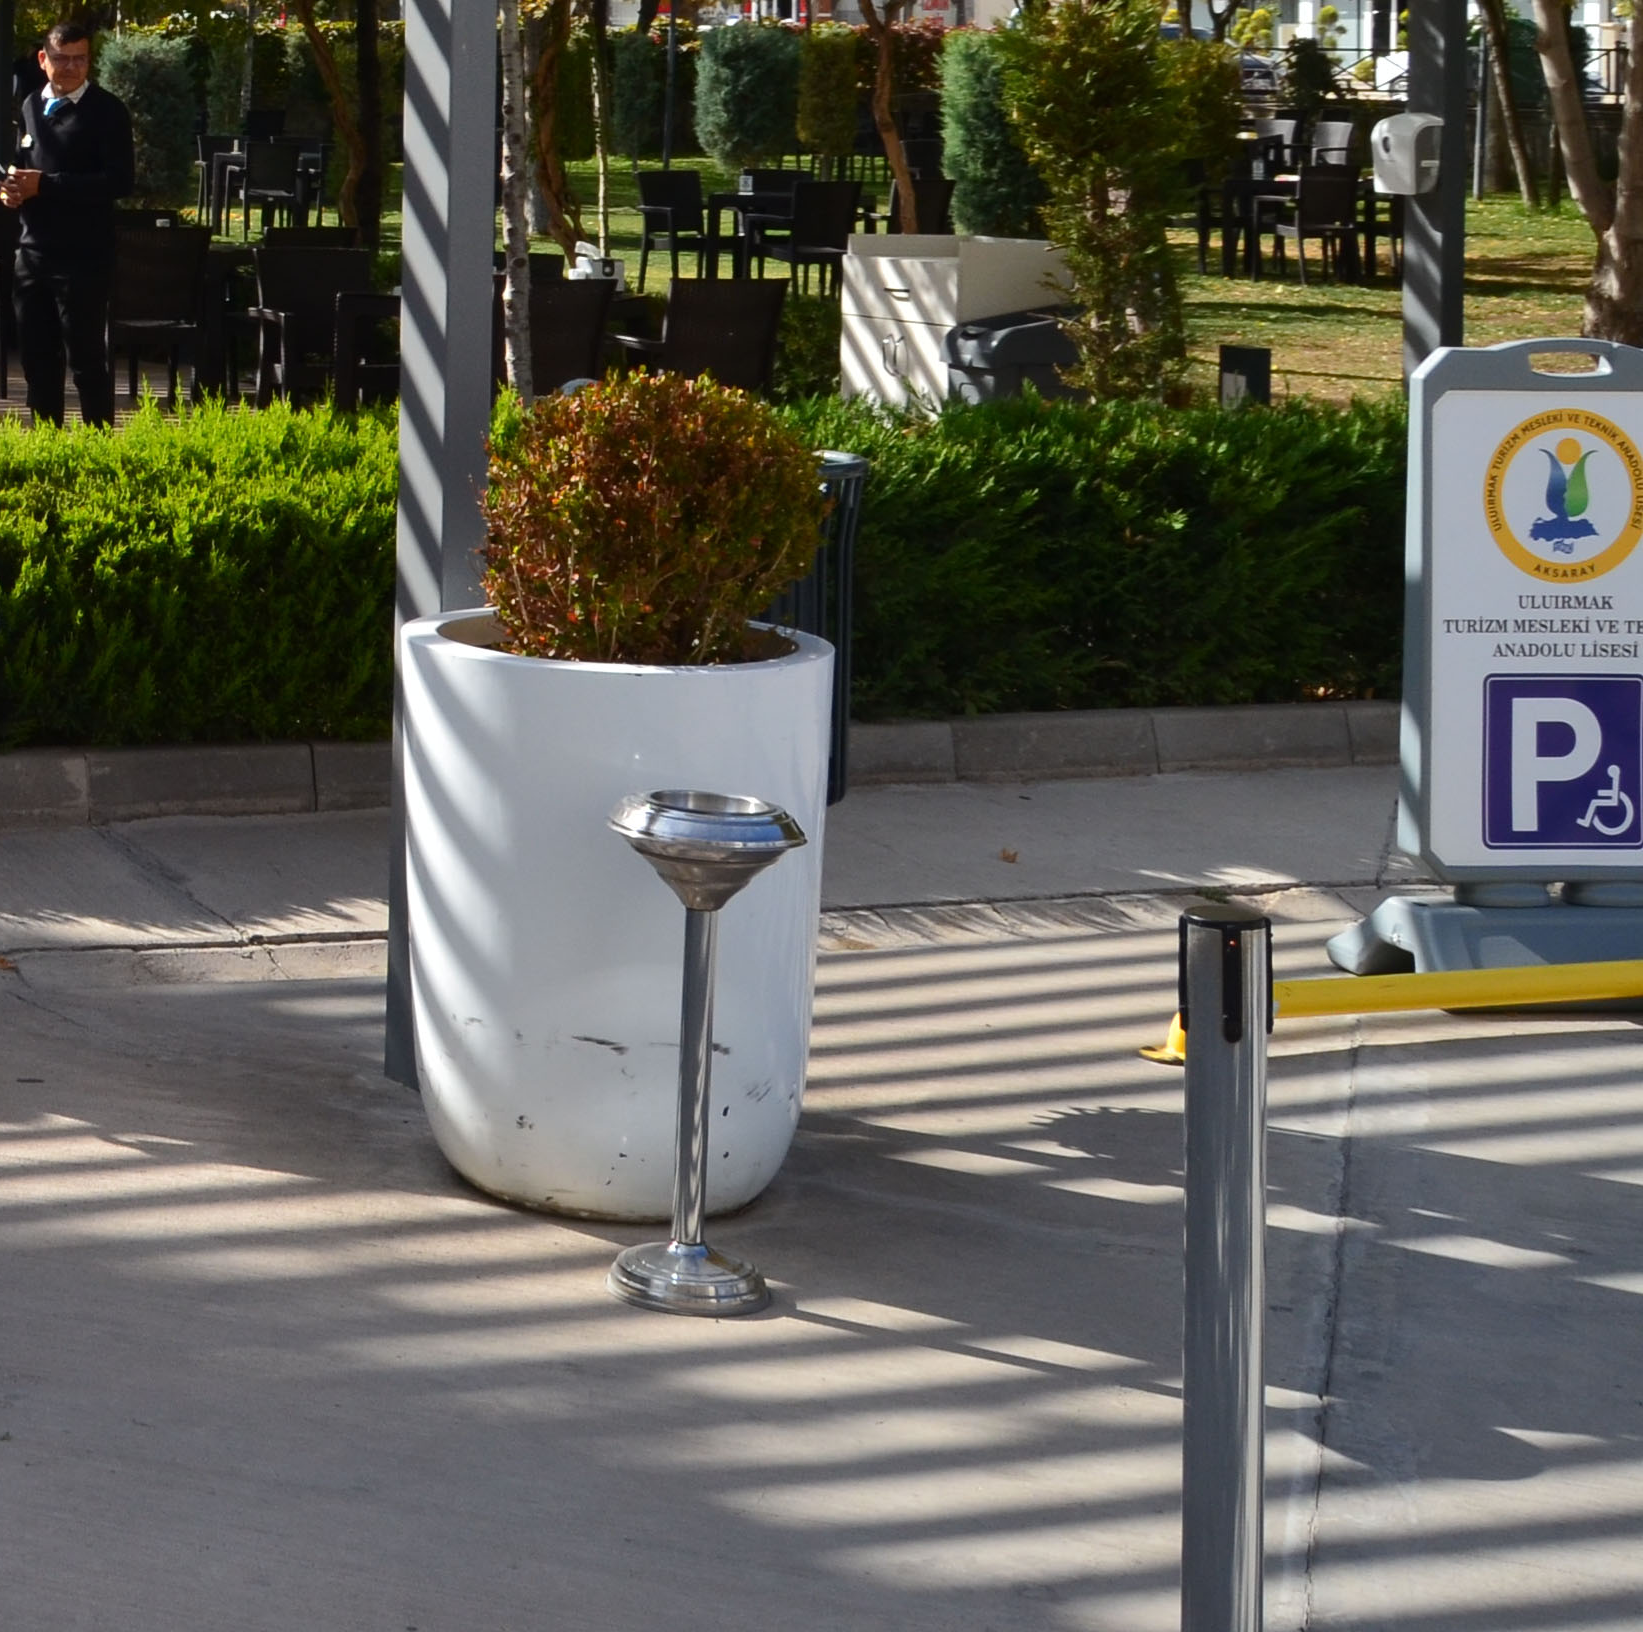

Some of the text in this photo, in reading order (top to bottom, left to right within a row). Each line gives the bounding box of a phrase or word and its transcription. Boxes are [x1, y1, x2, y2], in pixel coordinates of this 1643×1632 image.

[1487, 474, 1502, 532] ULUIRMAK
[1521, 411, 1563, 435] MESLEKİ
[1567, 413, 1580, 424] VE
[1584, 416, 1619, 440] TEKNİK
[1534, 563, 1596, 579] AKSARAY
[1518, 595, 1613, 610] ULUIRMAK
[1443, 616, 1508, 634] TURİZM
[1513, 616, 1590, 634] MESLEKİ
[1596, 619, 1619, 634] VE
[1493, 640, 1639, 658] ANADOLU LİSESİ
[1512, 698, 1602, 831] P
